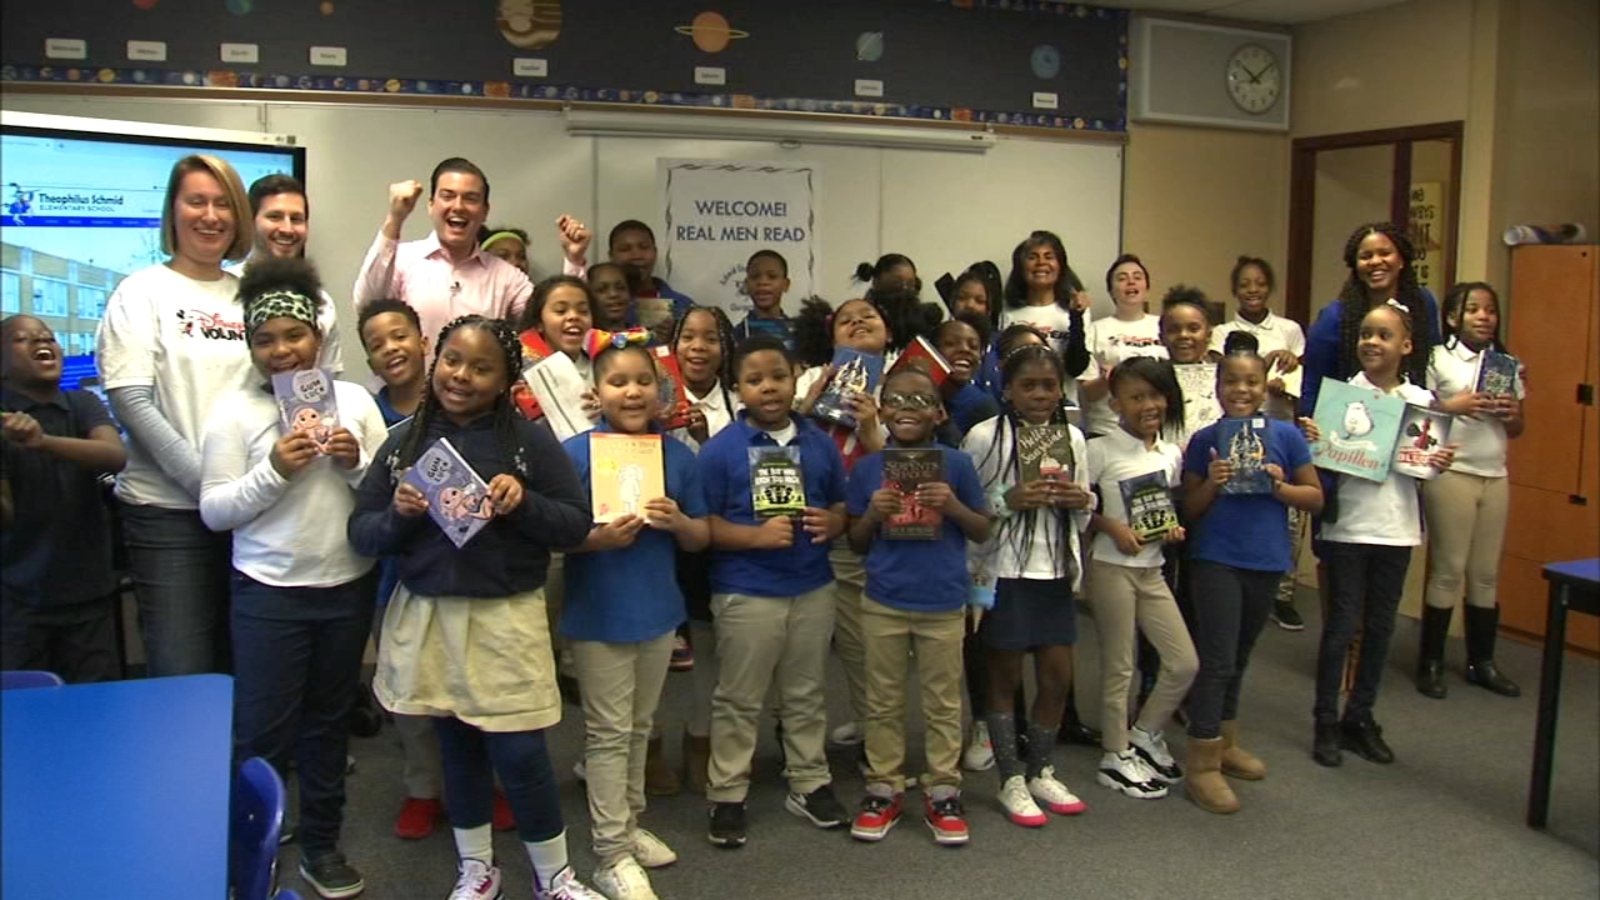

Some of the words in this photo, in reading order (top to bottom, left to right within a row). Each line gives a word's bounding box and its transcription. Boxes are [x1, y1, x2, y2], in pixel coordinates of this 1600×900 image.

[38, 193, 89, 206] Theophilus
[91, 194, 124, 205] Schmid
[694, 200, 787, 217] WELCOME!
[676, 226, 716, 241] REAL
[720, 227, 758, 241] MEN
[763, 227, 806, 242] READ
